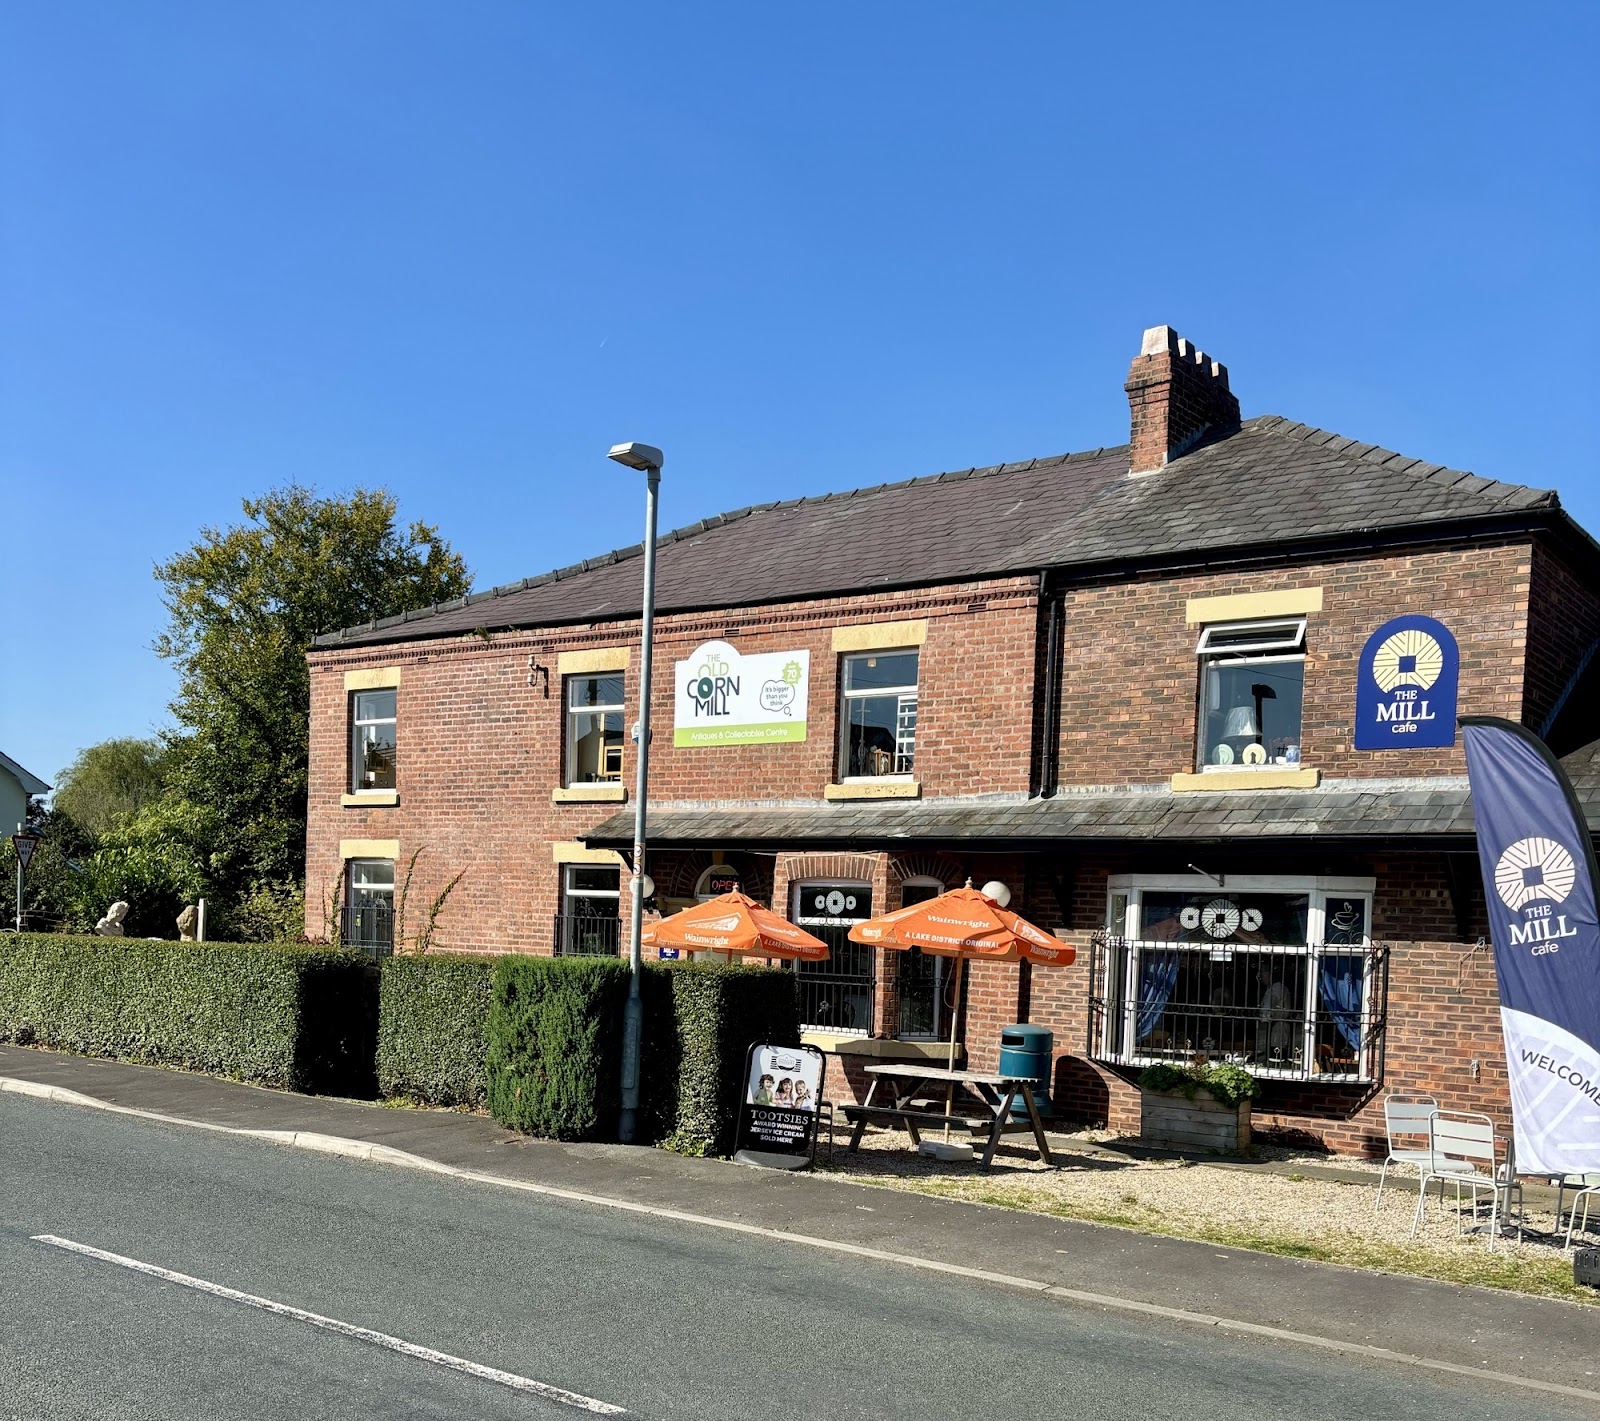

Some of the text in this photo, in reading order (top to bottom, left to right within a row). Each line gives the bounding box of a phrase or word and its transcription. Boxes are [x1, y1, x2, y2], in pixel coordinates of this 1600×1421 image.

[706, 654, 721, 662] THE
[698, 662, 729, 678] OLD
[687, 676, 740, 699] CORN
[1395, 690, 1418, 700] THE
[695, 696, 730, 717] MILL
[1376, 701, 1436, 722] MILL
[1391, 721, 1417, 733] cafe
[691, 732, 718, 741] Antiques
[725, 729, 764, 739] Collectables
[765, 728, 788, 737] Centre
[18, 840, 32, 848] GIVE
[1525, 905, 1552, 919] THE
[927, 915, 990, 928] Wainwright
[1509, 915, 1577, 945] MILL
[684, 932, 729, 947] Wainwright
[911, 932, 930, 940] LAKE
[931, 935, 964, 945] DISTRICT
[965, 939, 1000, 949] ORIGINAL
[1531, 941, 1559, 956] cafe
[751, 1109, 809, 1125] TOOTSIES
[750, 1126, 773, 1134] JERSEY
[783, 1130, 805, 1138] CREAM
[753, 1120, 804, 1131] AWARD WINNING
[760, 1134, 793, 1144] SOLD HERE
